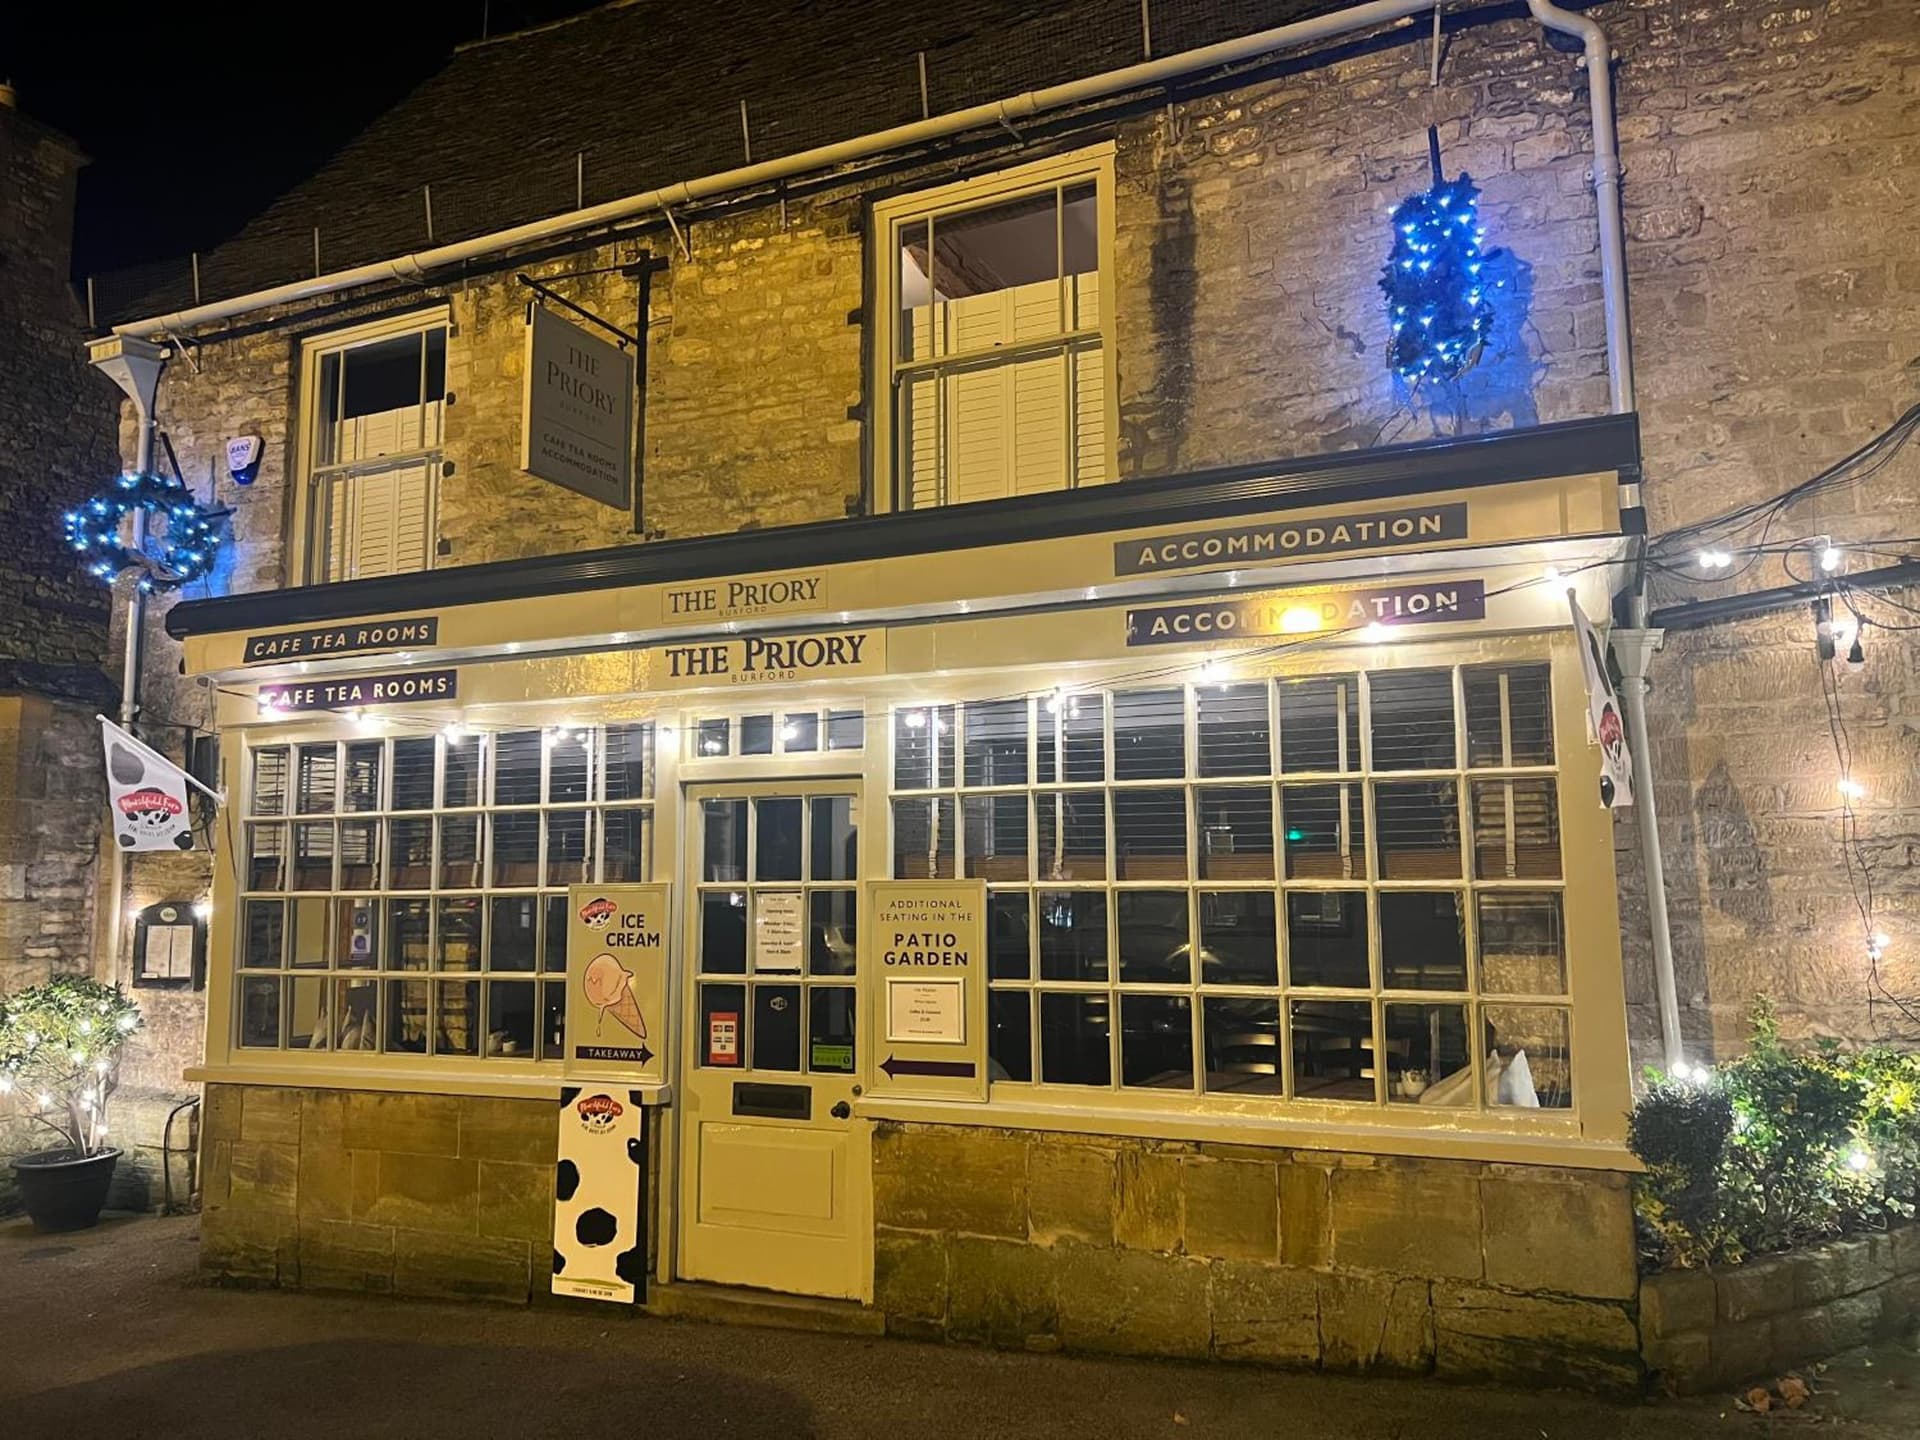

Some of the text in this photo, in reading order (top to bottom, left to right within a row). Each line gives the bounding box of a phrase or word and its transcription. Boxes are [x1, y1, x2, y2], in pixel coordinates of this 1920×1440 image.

[567, 344, 600, 376] THE
[547, 360, 617, 415] PRIORY
[543, 433, 617, 472] CAFE TEA ROOMS
[541, 447, 619, 485] ACCOMMODATION
[1138, 514, 1442, 565] ACCOMMODATION
[668, 577, 820, 614] THE PRIORY
[719, 605, 767, 617] BURFORD
[1150, 590, 1458, 636] ACCOMMDATION
[253, 624, 429, 656] CAFE TEA ROOMS
[665, 634, 867, 677] THE PRIORY
[731, 670, 795, 683] BURFORD
[325, 685, 362, 701] TEA
[373, 677, 447, 699] ROOMS
[880, 912, 973, 921] SEATING IN THE
[890, 900, 962, 909] ADDITIONAL
[621, 913, 645, 929] ICE
[606, 932, 660, 948] CREAM
[894, 933, 957, 948] PATIO
[884, 951, 968, 966] GARDEN
[588, 1048, 642, 1060] TAKEAWAY
